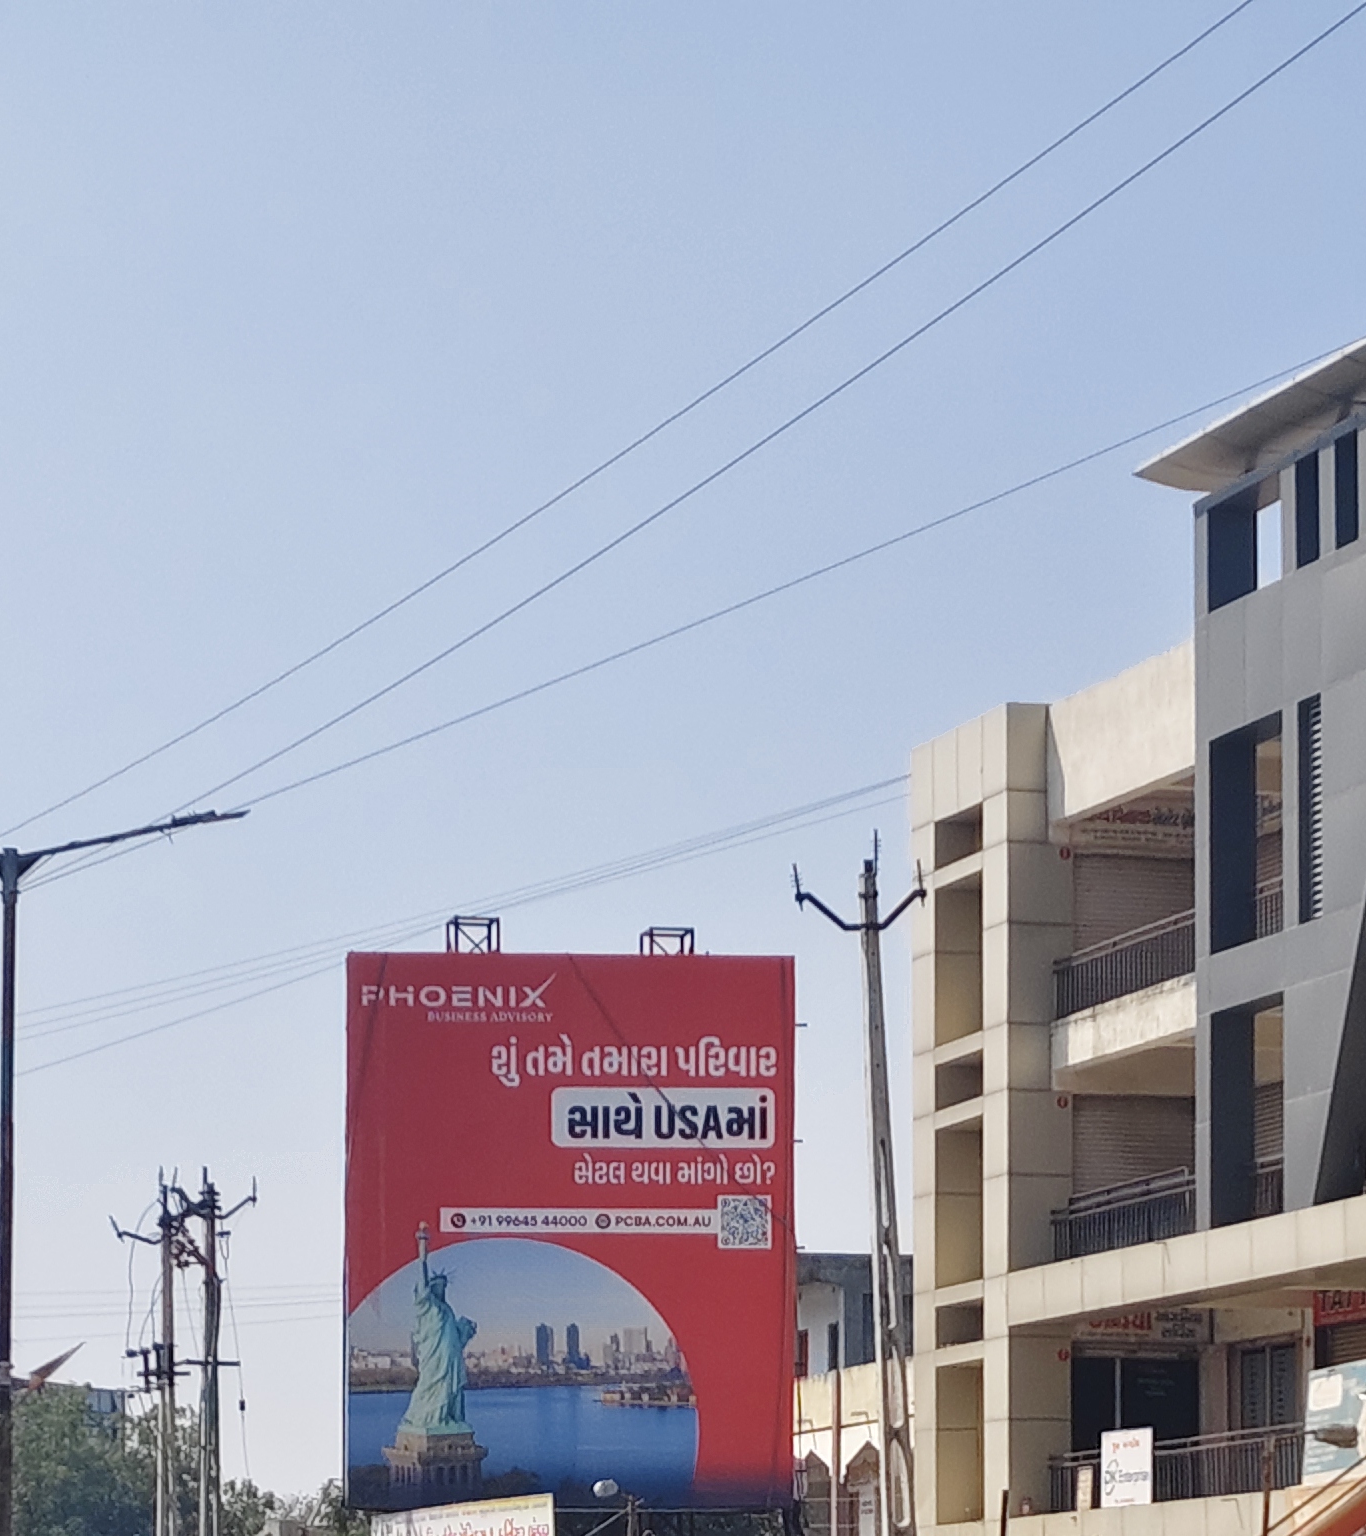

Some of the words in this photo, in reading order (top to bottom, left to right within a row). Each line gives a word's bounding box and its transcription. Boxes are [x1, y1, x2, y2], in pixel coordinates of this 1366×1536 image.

[360, 972, 557, 1008] PHOENIX
[427, 1011, 487, 1023] BUSINESS
[490, 1011, 554, 1023] ADVISORY
[490, 1036, 520, 1088] શું
[525, 1033, 574, 1078] તમે
[580, 1044, 668, 1078] તમારા
[675, 1035, 778, 1078] પરિવાર
[567, 1091, 643, 1140] સાથે
[653, 1095, 769, 1140] USAમાં
[573, 1152, 626, 1185] સેટલ
[631, 1161, 672, 1185] થવા
[675, 1154, 728, 1185] માંગો
[734, 1153, 776, 1186] છો?
[541, 1215, 587, 1227] 44000
[615, 1215, 712, 1227] PCBA.COM.AU
